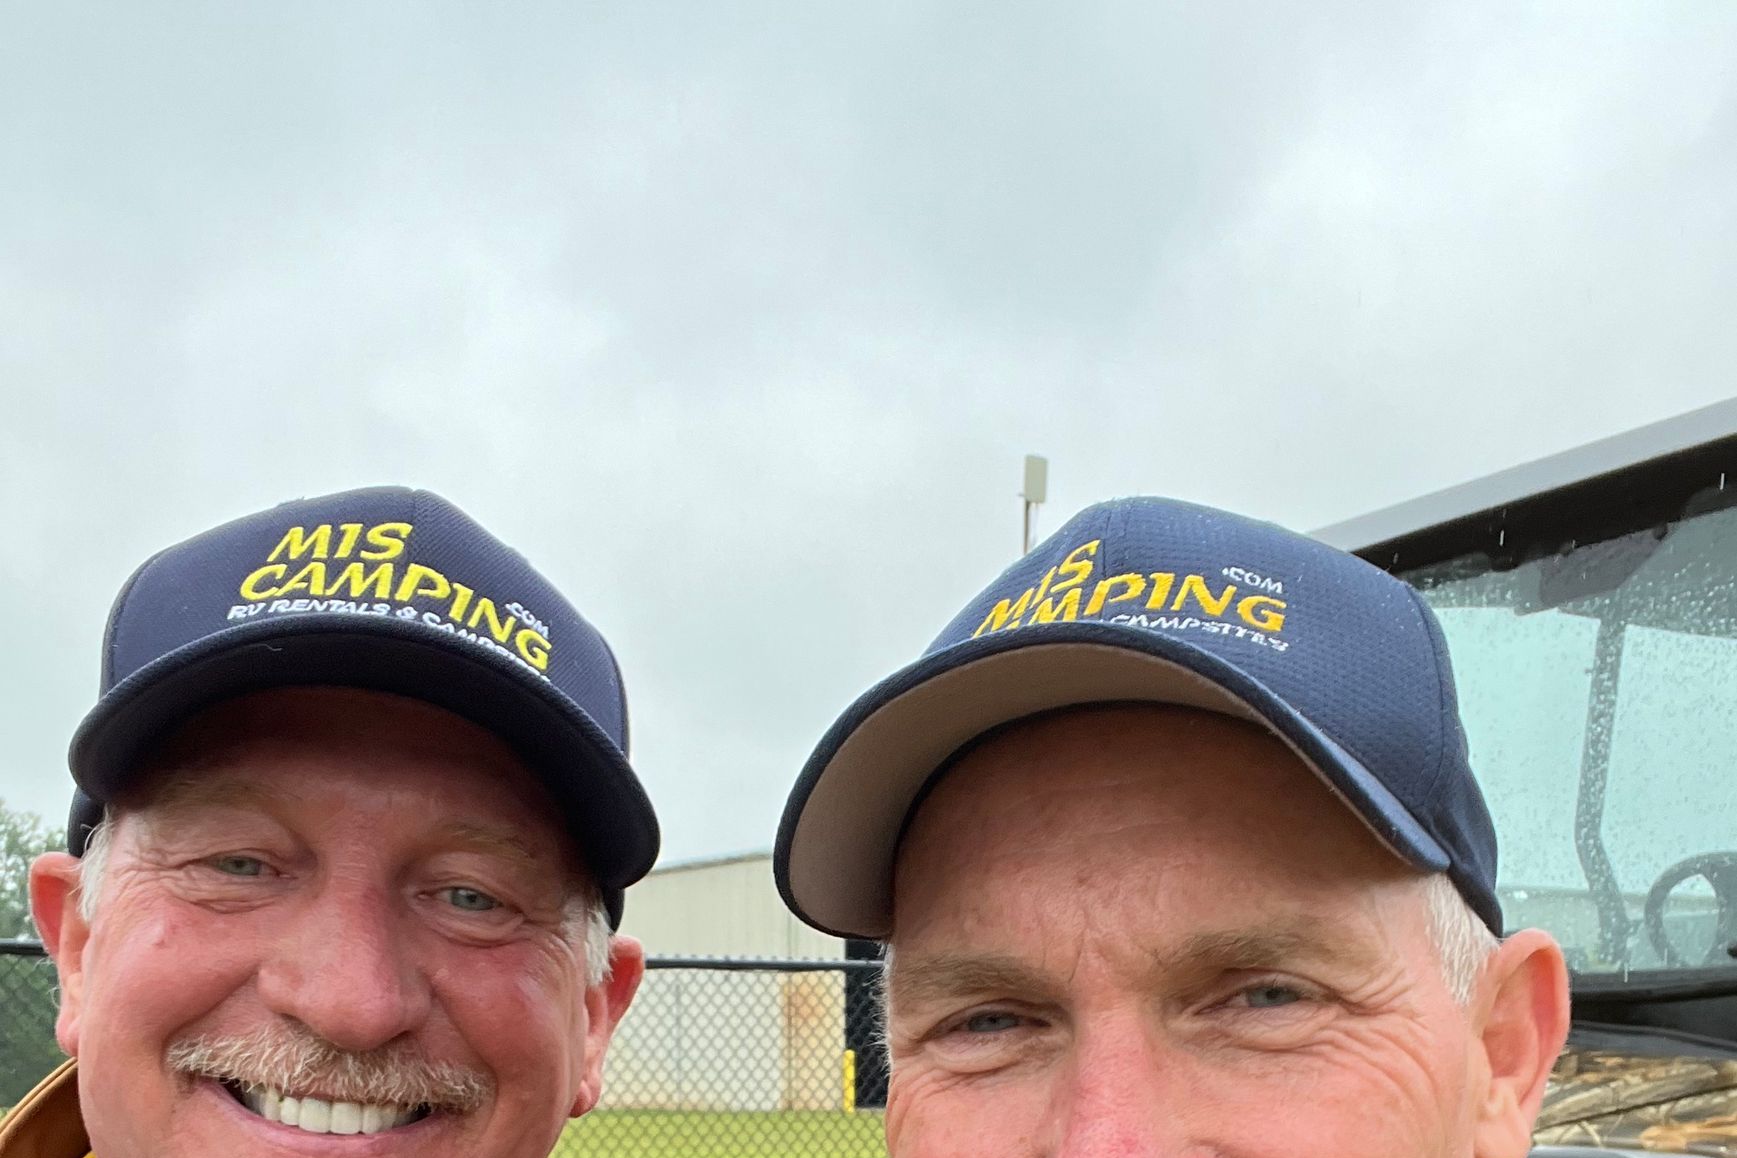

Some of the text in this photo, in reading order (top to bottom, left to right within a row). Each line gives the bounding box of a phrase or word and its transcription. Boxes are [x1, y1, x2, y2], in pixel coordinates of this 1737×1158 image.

[267, 522, 413, 562] MIS
[227, 602, 266, 620] RV
[268, 598, 391, 616] RENTALS
[240, 561, 552, 671] CAMPING
[972, 539, 1100, 638] MIS
